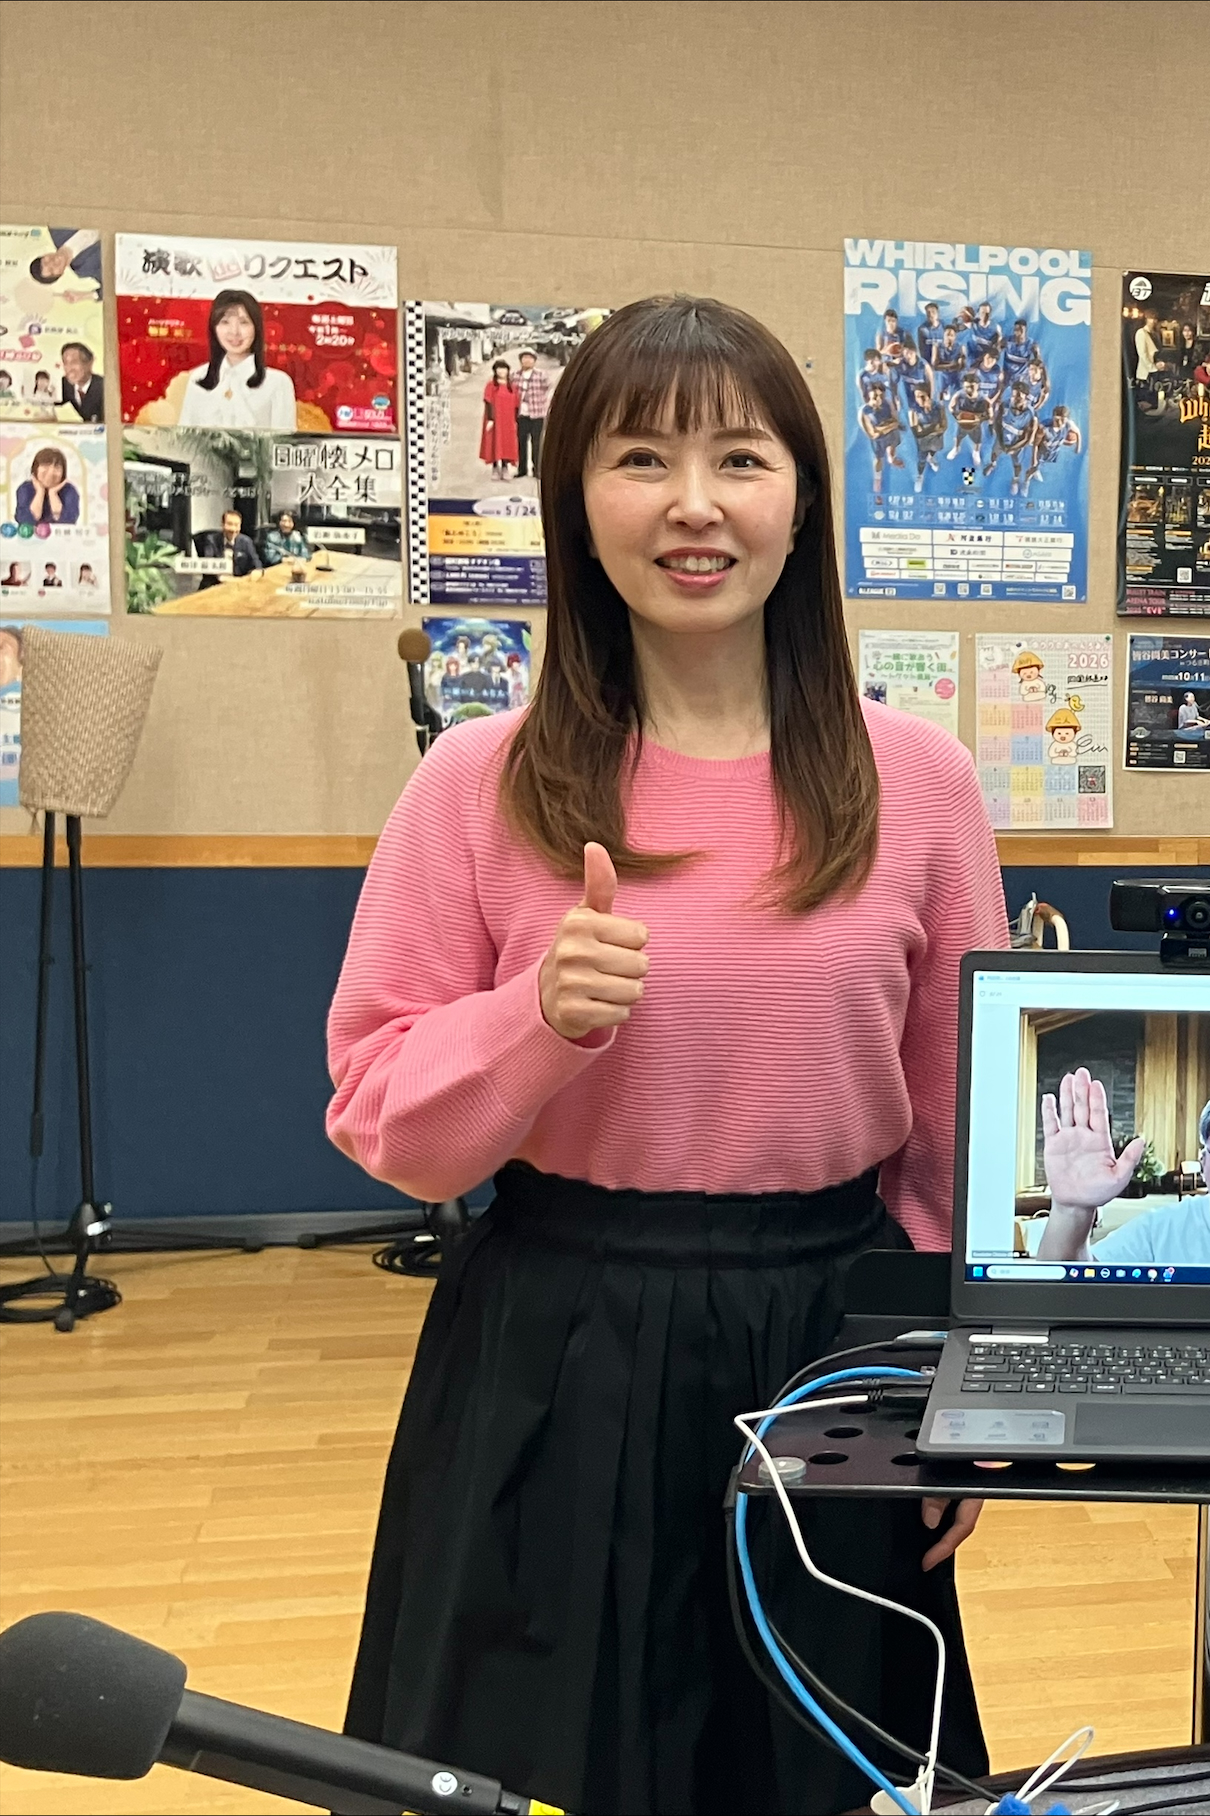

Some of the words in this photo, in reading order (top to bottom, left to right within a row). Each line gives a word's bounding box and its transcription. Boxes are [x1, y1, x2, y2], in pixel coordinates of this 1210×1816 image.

[844, 238, 1091, 277] WHIRLPOOL
[844, 267, 1091, 326] RISING
[274, 443, 395, 471] 日曜懐メロ
[299, 474, 378, 504] 大全集
[882, 532, 907, 540] Media
[1068, 653, 1109, 668] 2026
